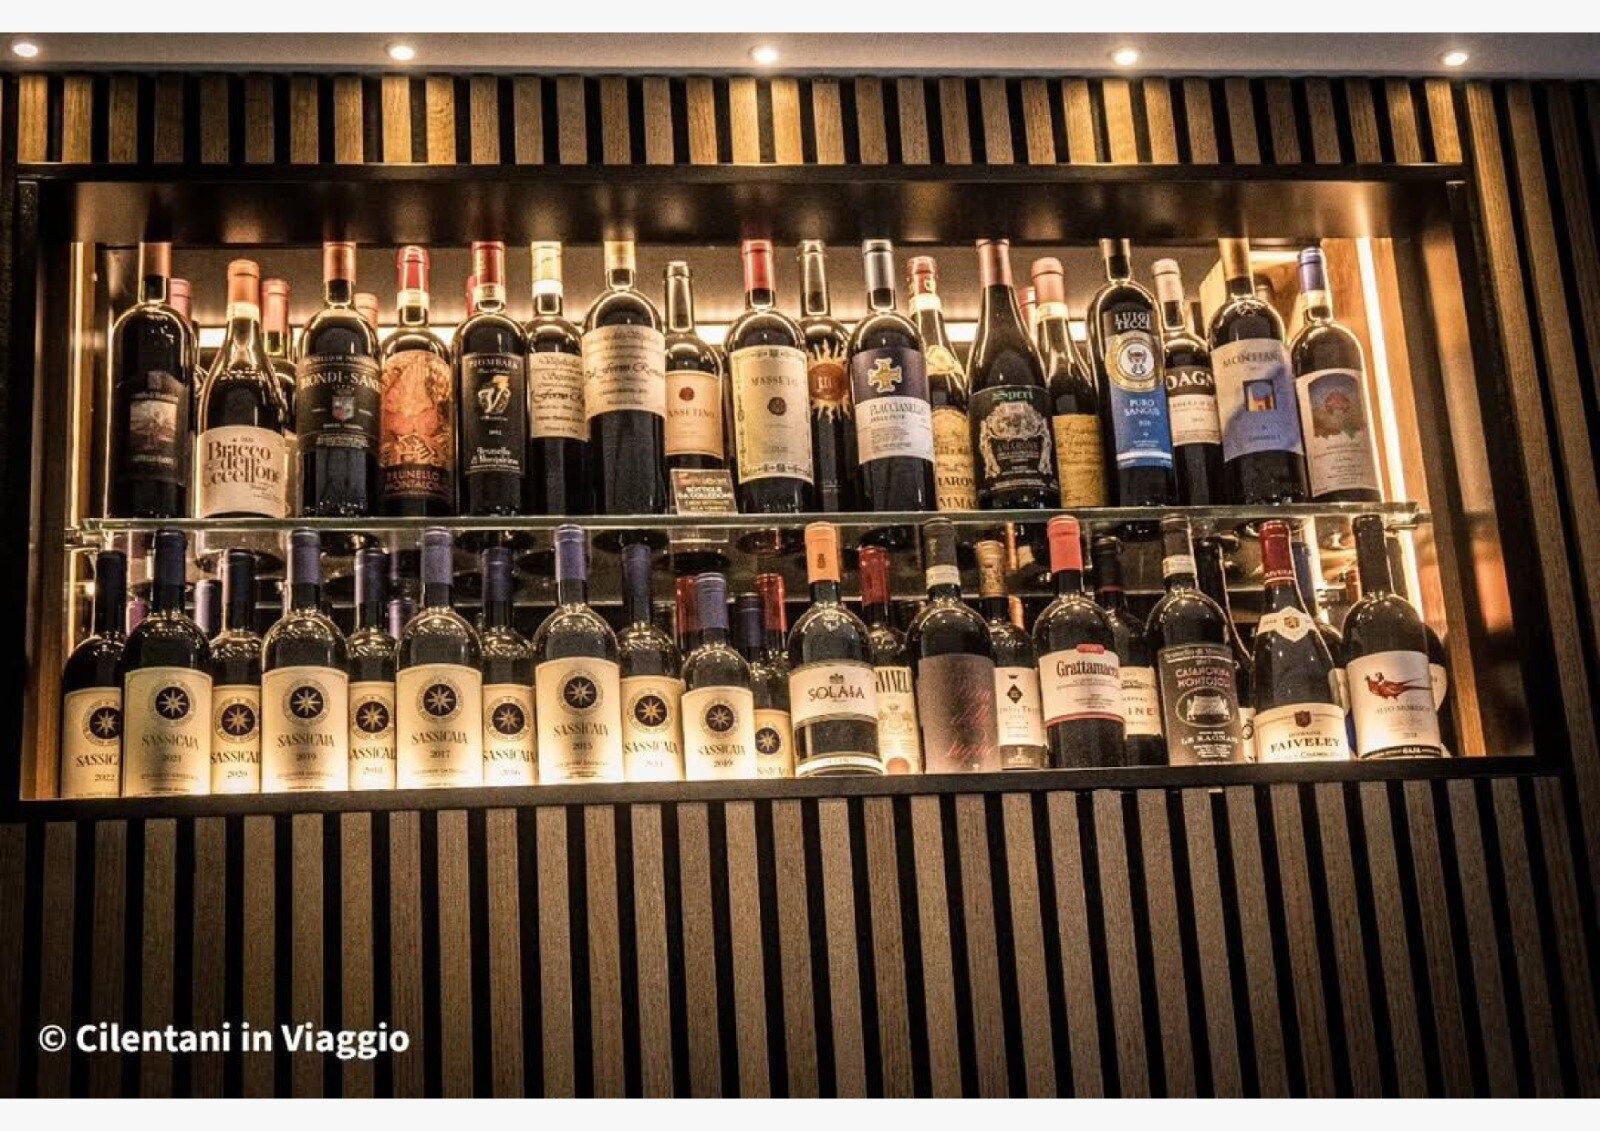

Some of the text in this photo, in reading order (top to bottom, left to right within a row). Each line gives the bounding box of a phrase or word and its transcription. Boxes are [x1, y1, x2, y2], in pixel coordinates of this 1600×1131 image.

[208, 440, 272, 461] Bricco
[1056, 659, 1119, 679] Grattamac
[807, 685, 865, 702] SOLAIA
[410, 730, 469, 745] SASSICAIA
[553, 722, 609, 738] SASSICAIA
[141, 733, 200, 750] SASSICAIA
[277, 733, 335, 748] SASSICAIA
[1270, 736, 1340, 753] FAIVELEY
[75, 754, 117, 768] SASSIC
[210, 751, 260, 764] SASSICAI
[349, 747, 397, 760] ASSICAI
